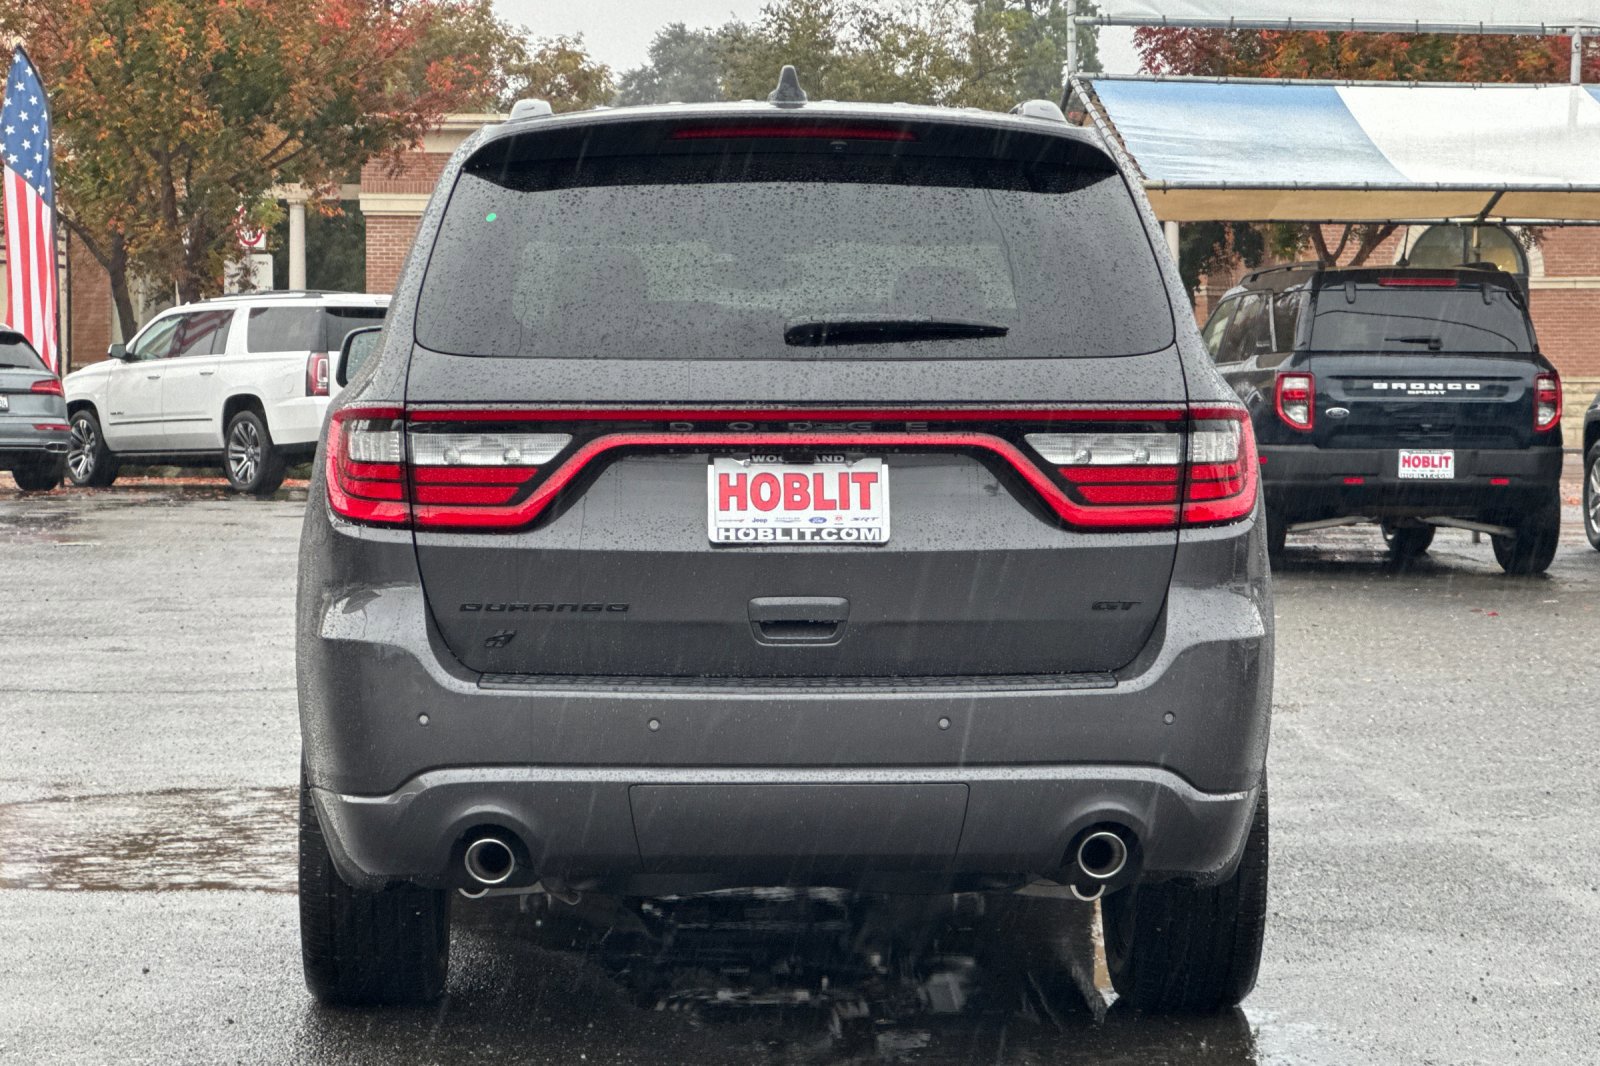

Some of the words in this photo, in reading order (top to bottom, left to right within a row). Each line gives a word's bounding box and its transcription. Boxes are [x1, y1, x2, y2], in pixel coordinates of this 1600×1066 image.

[1373, 382, 1480, 390] BRONCO
[669, 421, 928, 432] DODGE
[752, 454, 845, 463] WOAND
[1402, 455, 1452, 469] HOBLIT
[718, 472, 879, 512] HOBLIT
[718, 528, 881, 541] HOBLIT.COM
[459, 602, 630, 613] DURANGO
[1092, 601, 1142, 611] GT
